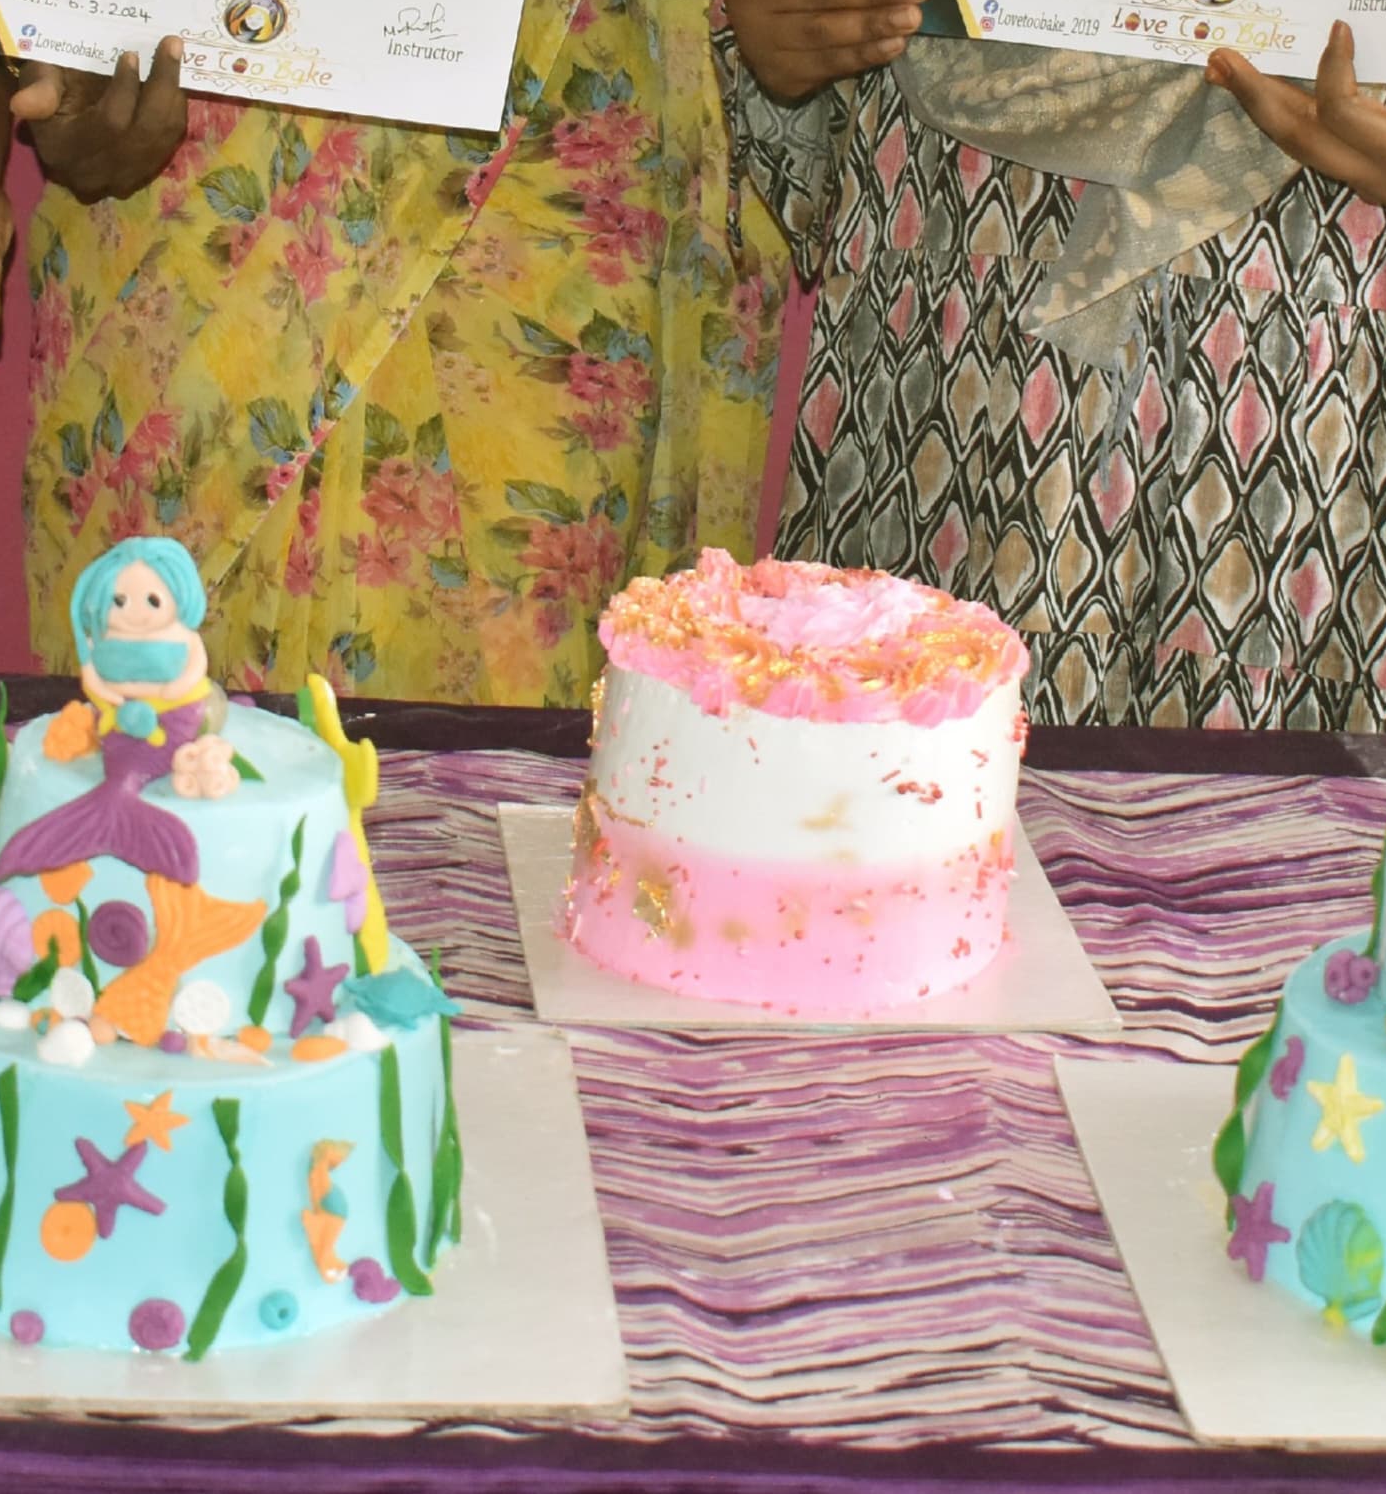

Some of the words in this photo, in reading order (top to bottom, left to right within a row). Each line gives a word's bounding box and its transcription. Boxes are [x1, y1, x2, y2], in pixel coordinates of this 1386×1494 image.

[997, 8, 1100, 36] Lovetoobake_2019
[1235, 20, 1296, 50] Bake
[35, 33, 124, 65] Lovetoobake_2
[387, 38, 464, 64] Instructor
[275, 60, 333, 88] Bake
